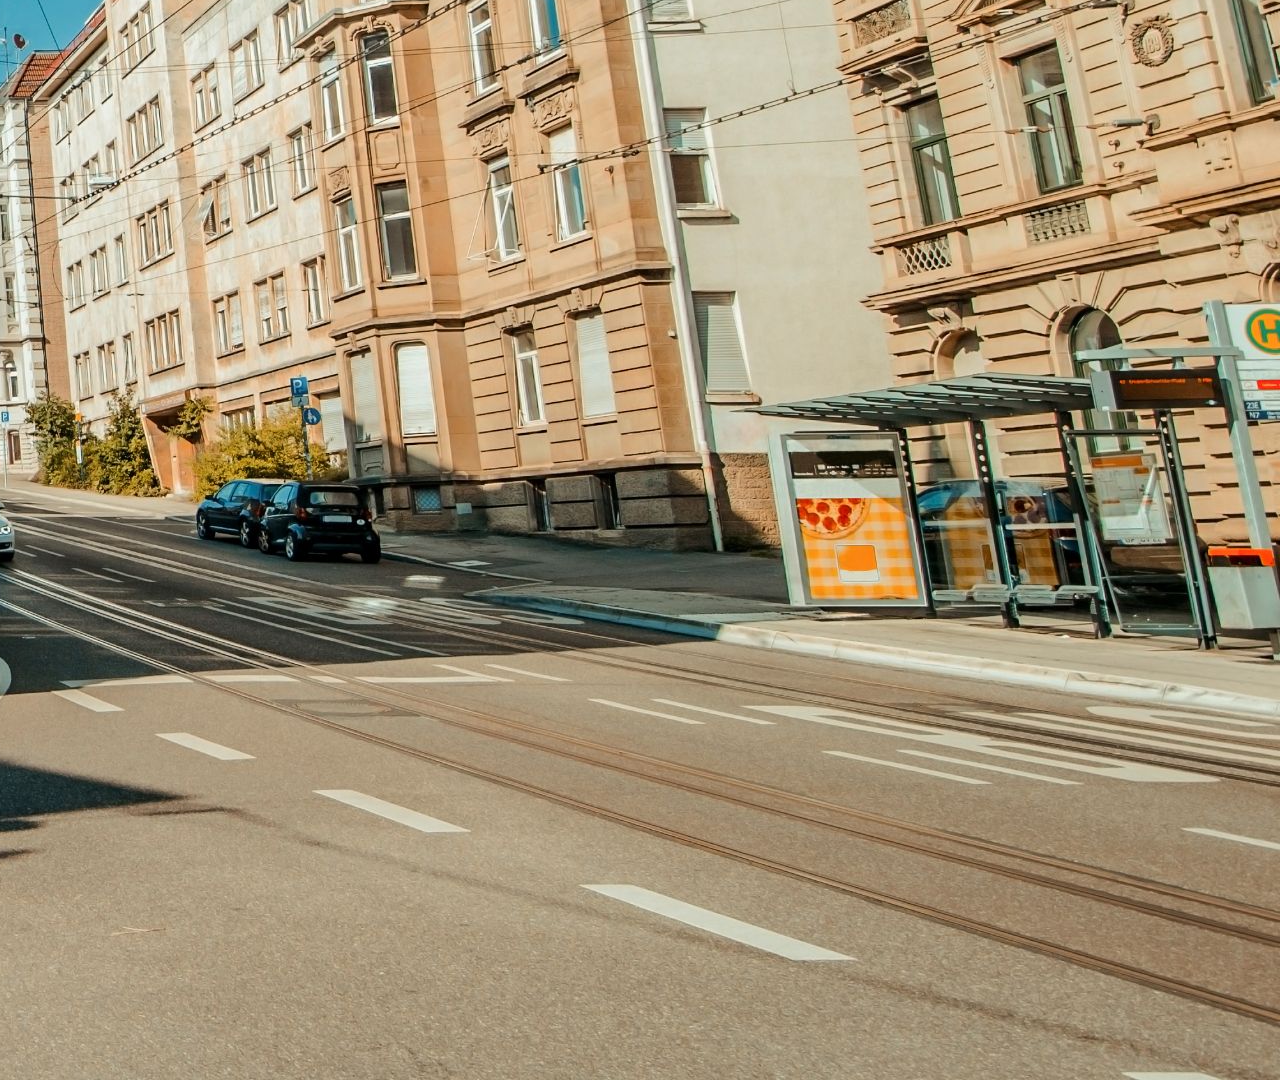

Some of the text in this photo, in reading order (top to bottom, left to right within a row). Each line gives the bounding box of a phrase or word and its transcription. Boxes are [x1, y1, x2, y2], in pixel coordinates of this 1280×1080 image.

[1259, 319, 1280, 342] H
[293, 379, 303, 394] P
[1246, 402, 1259, 410] 23E
